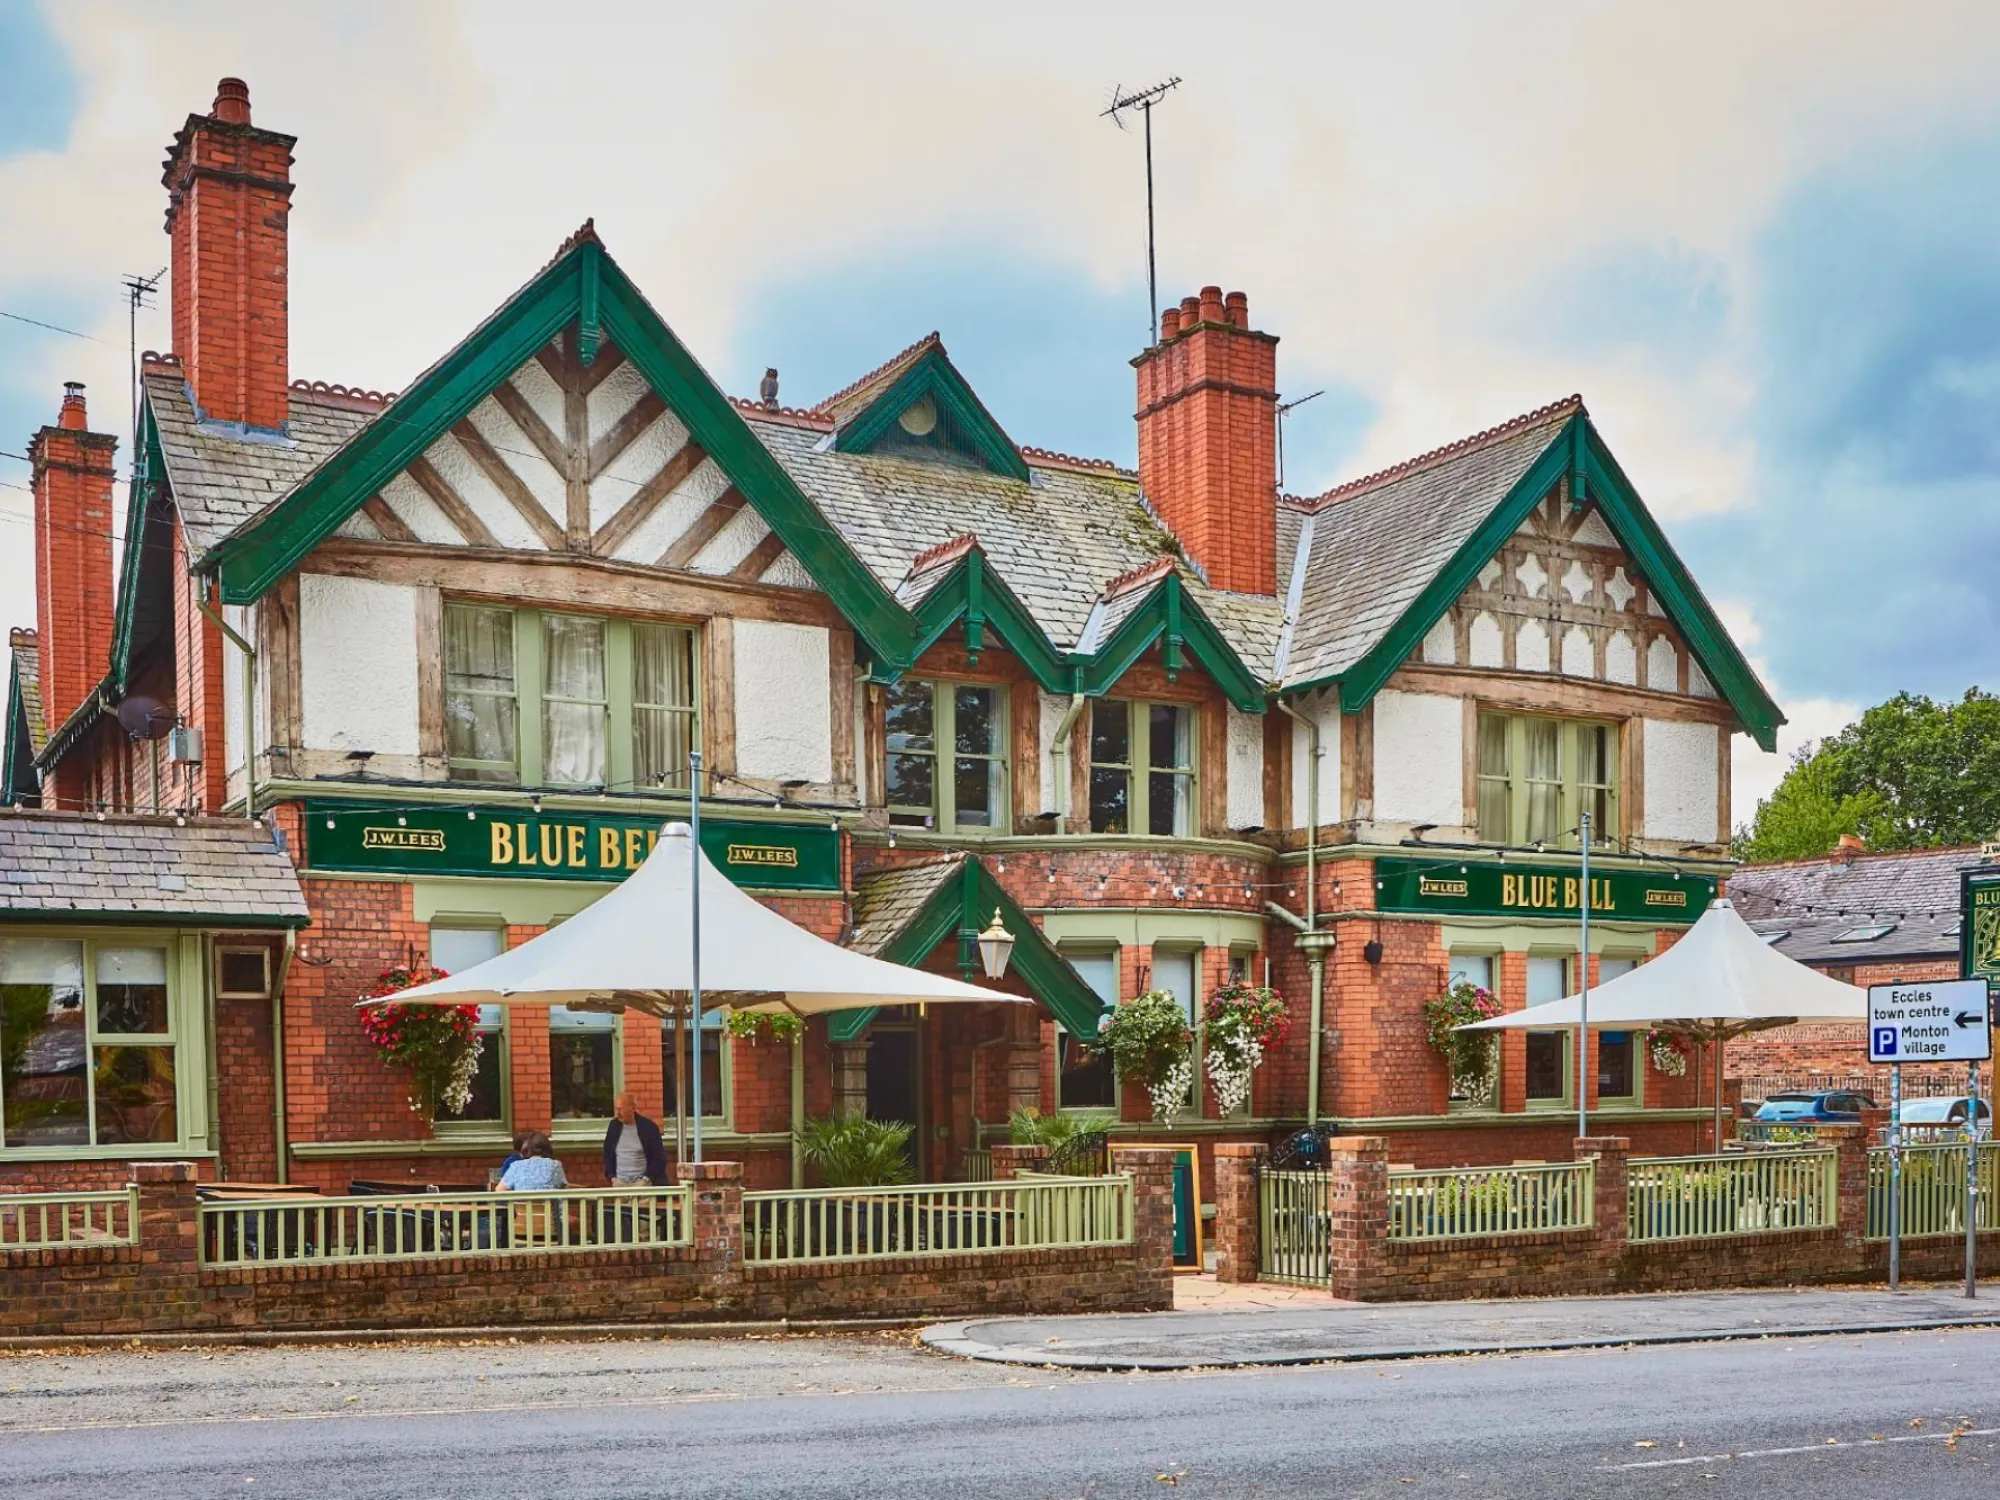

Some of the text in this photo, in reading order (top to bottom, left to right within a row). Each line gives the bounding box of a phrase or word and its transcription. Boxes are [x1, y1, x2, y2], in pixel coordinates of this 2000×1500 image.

[490, 822, 658, 870] BLUE BE
[1502, 874, 1558, 908] BLUE
[1891, 989, 1933, 1004] Eccles
[1873, 1004, 1951, 1020] town centre
[1901, 1024, 1951, 1039] Monton
[1878, 1029, 1895, 1054] P
[1903, 1041, 1947, 1056] village
